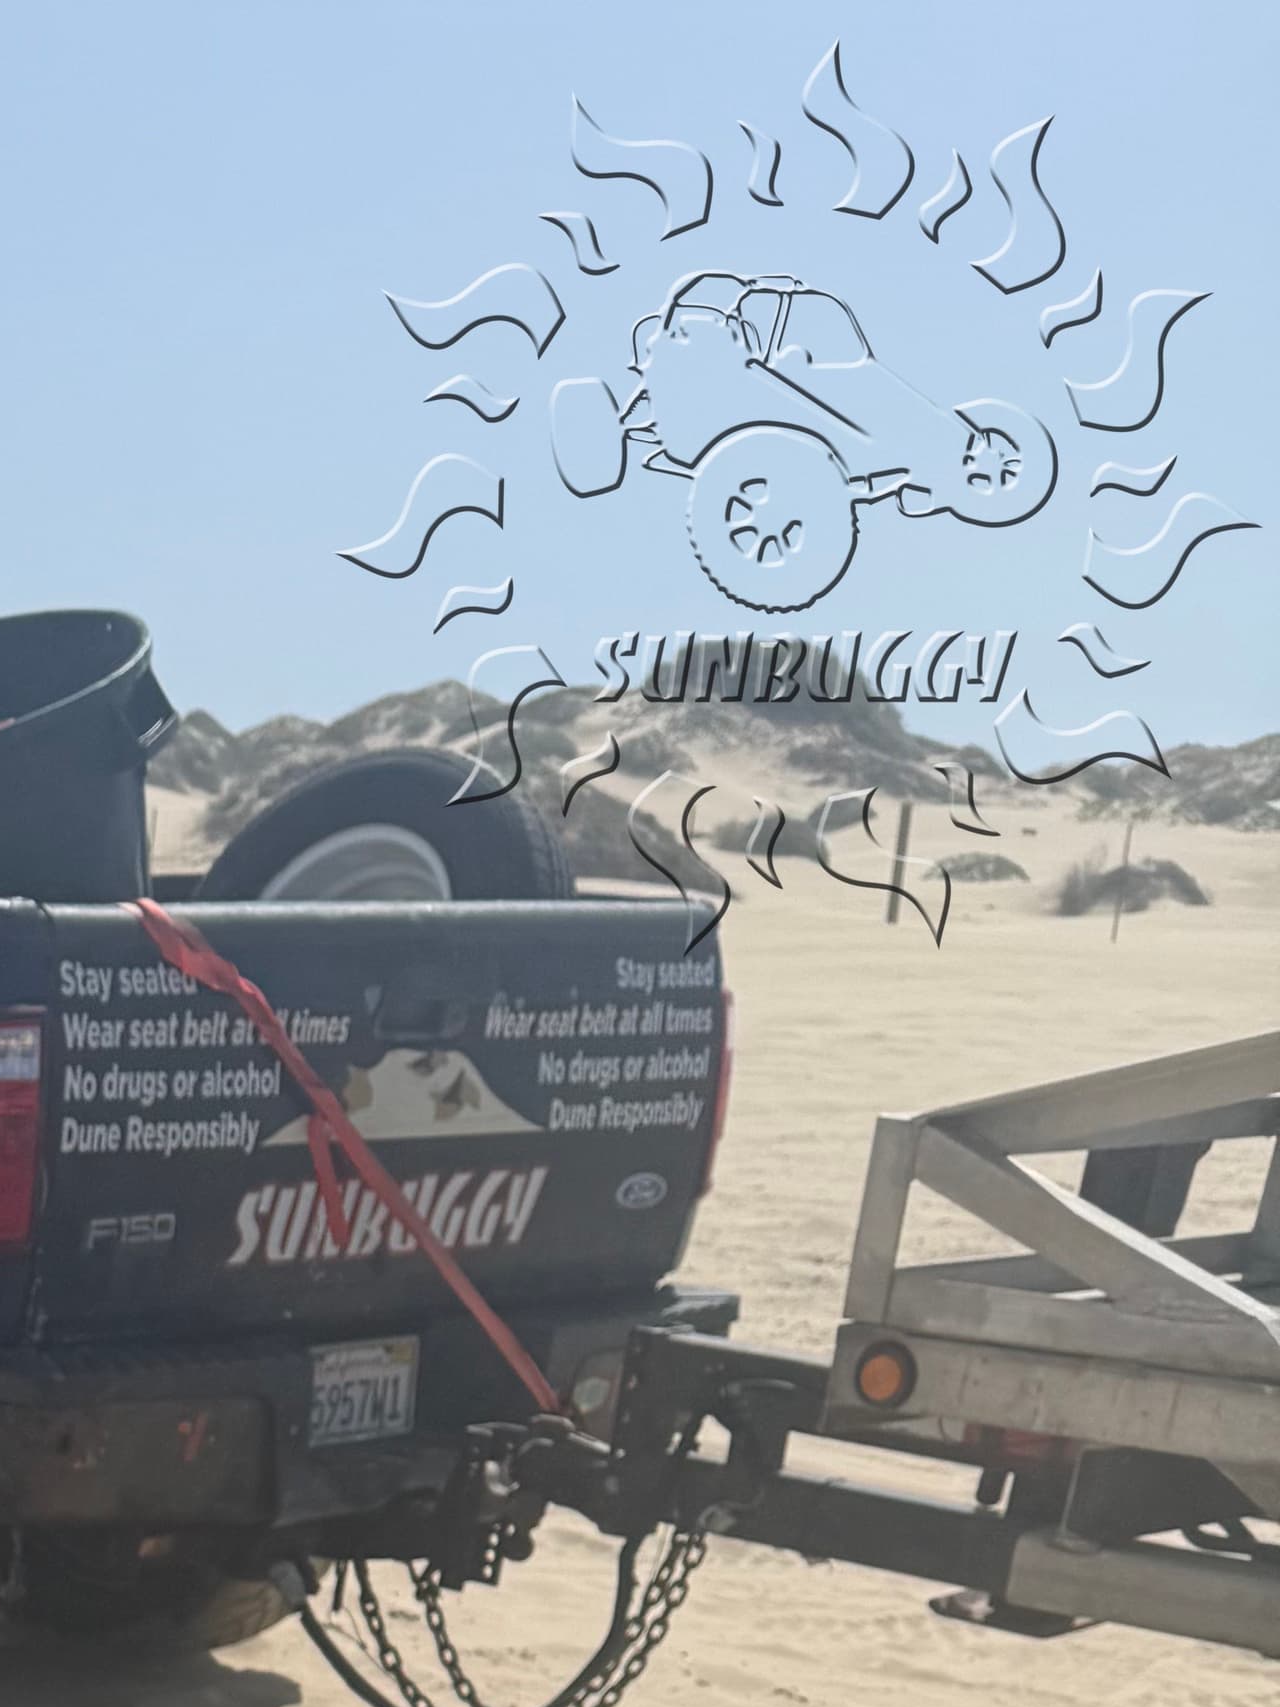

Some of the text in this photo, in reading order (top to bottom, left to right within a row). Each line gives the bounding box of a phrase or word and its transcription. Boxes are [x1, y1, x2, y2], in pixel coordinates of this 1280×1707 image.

[60, 959, 113, 1003] Stay
[615, 955, 716, 996] Stay seated
[62, 1011, 124, 1049] Wear
[129, 1012, 180, 1048] seat
[182, 1009, 230, 1047] belt
[290, 1008, 351, 1045] times
[484, 1004, 536, 1039] Wear
[536, 1004, 579, 1039] seat
[580, 1002, 618, 1037] belt
[618, 1003, 640, 1036] at
[641, 1000, 666, 1035] all
[63, 1060, 282, 1107] No drugs or alcohol
[538, 1047, 711, 1089] No drugs or alcohol
[60, 1110, 261, 1158] Dune Responsibly
[548, 1091, 705, 1135] Dune Responsibly
